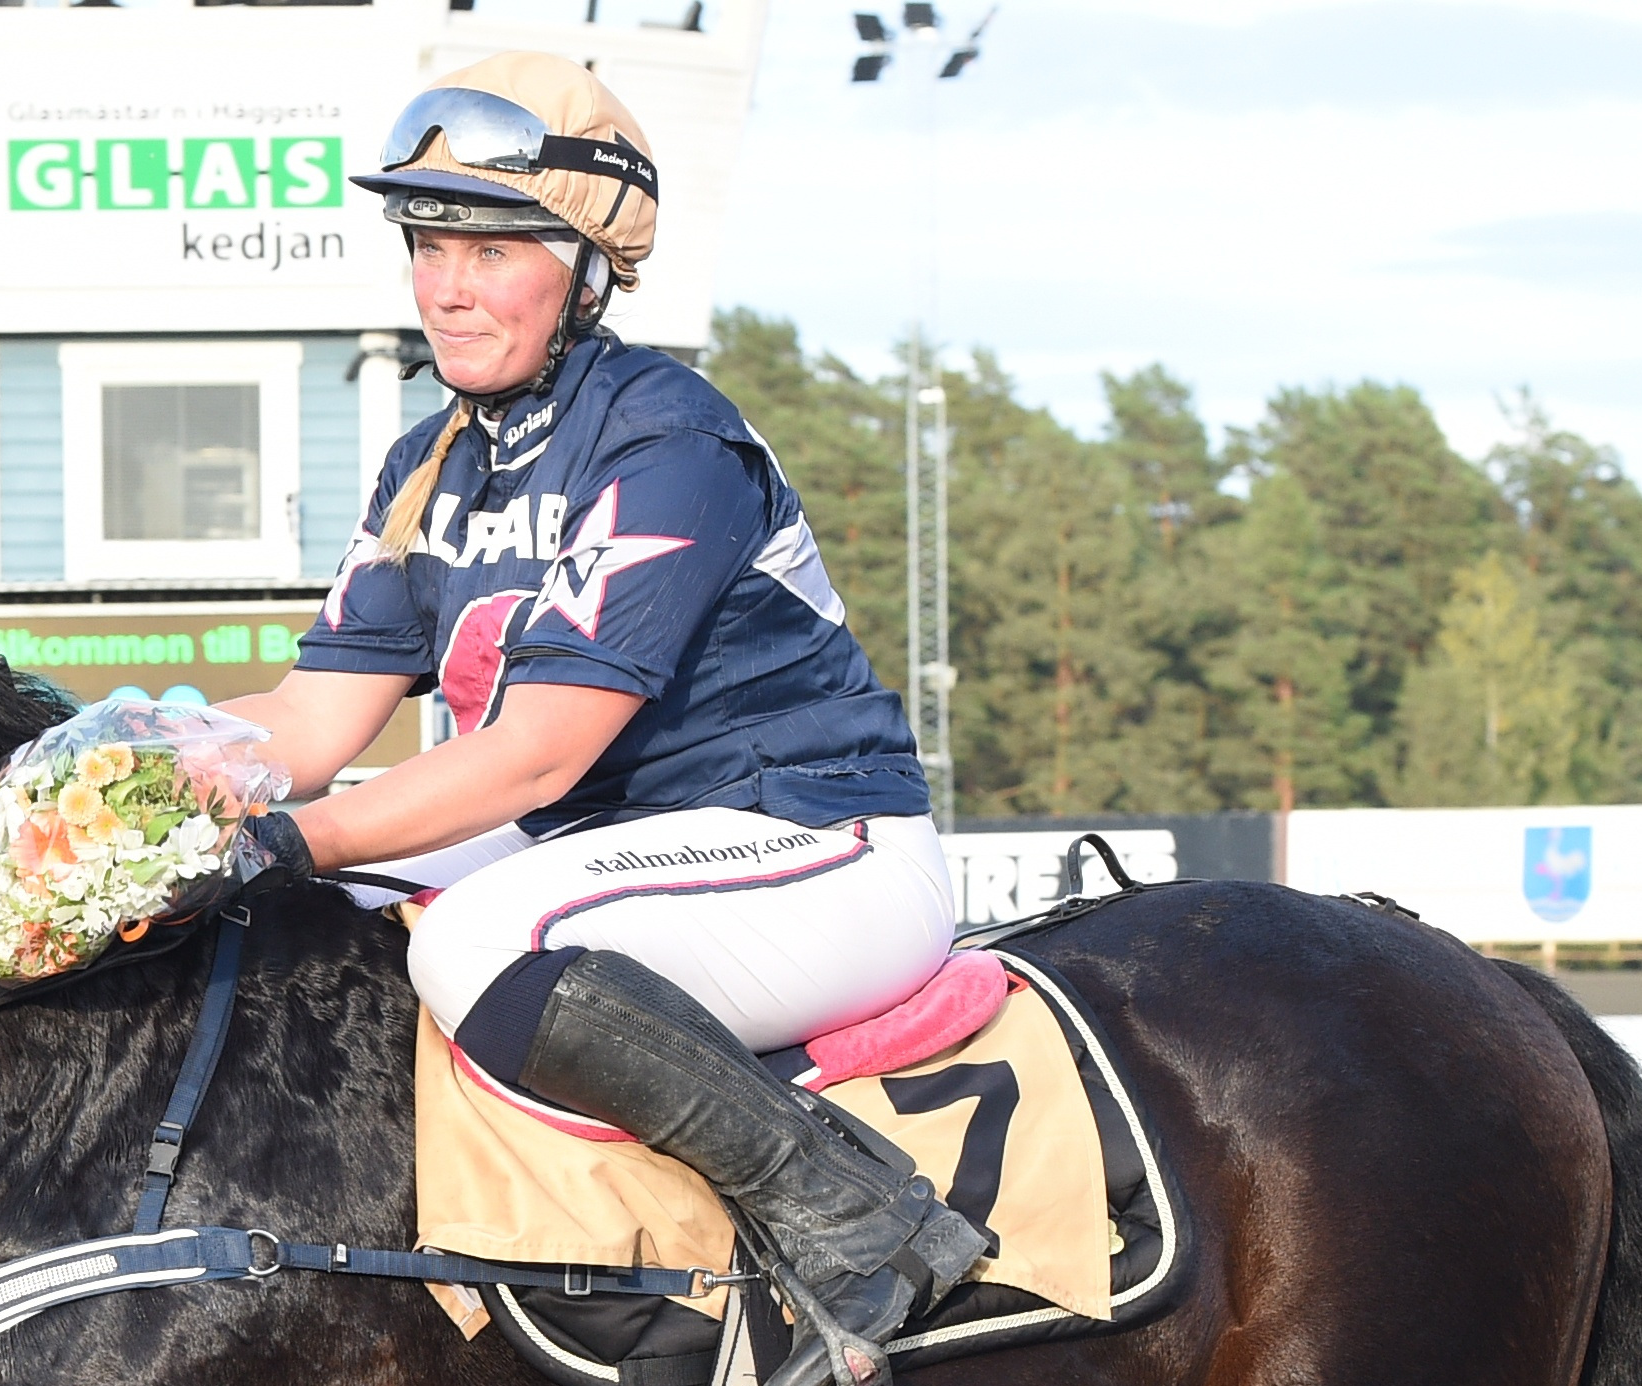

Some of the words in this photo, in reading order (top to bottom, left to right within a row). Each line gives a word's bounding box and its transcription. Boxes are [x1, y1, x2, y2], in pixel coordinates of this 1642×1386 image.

[17, 141, 330, 207] GLAS
[181, 221, 344, 271] kedjan
[201, 625, 252, 663] till
[584, 831, 821, 876] stallmahony.com
[879, 1060, 1020, 1260] 7
